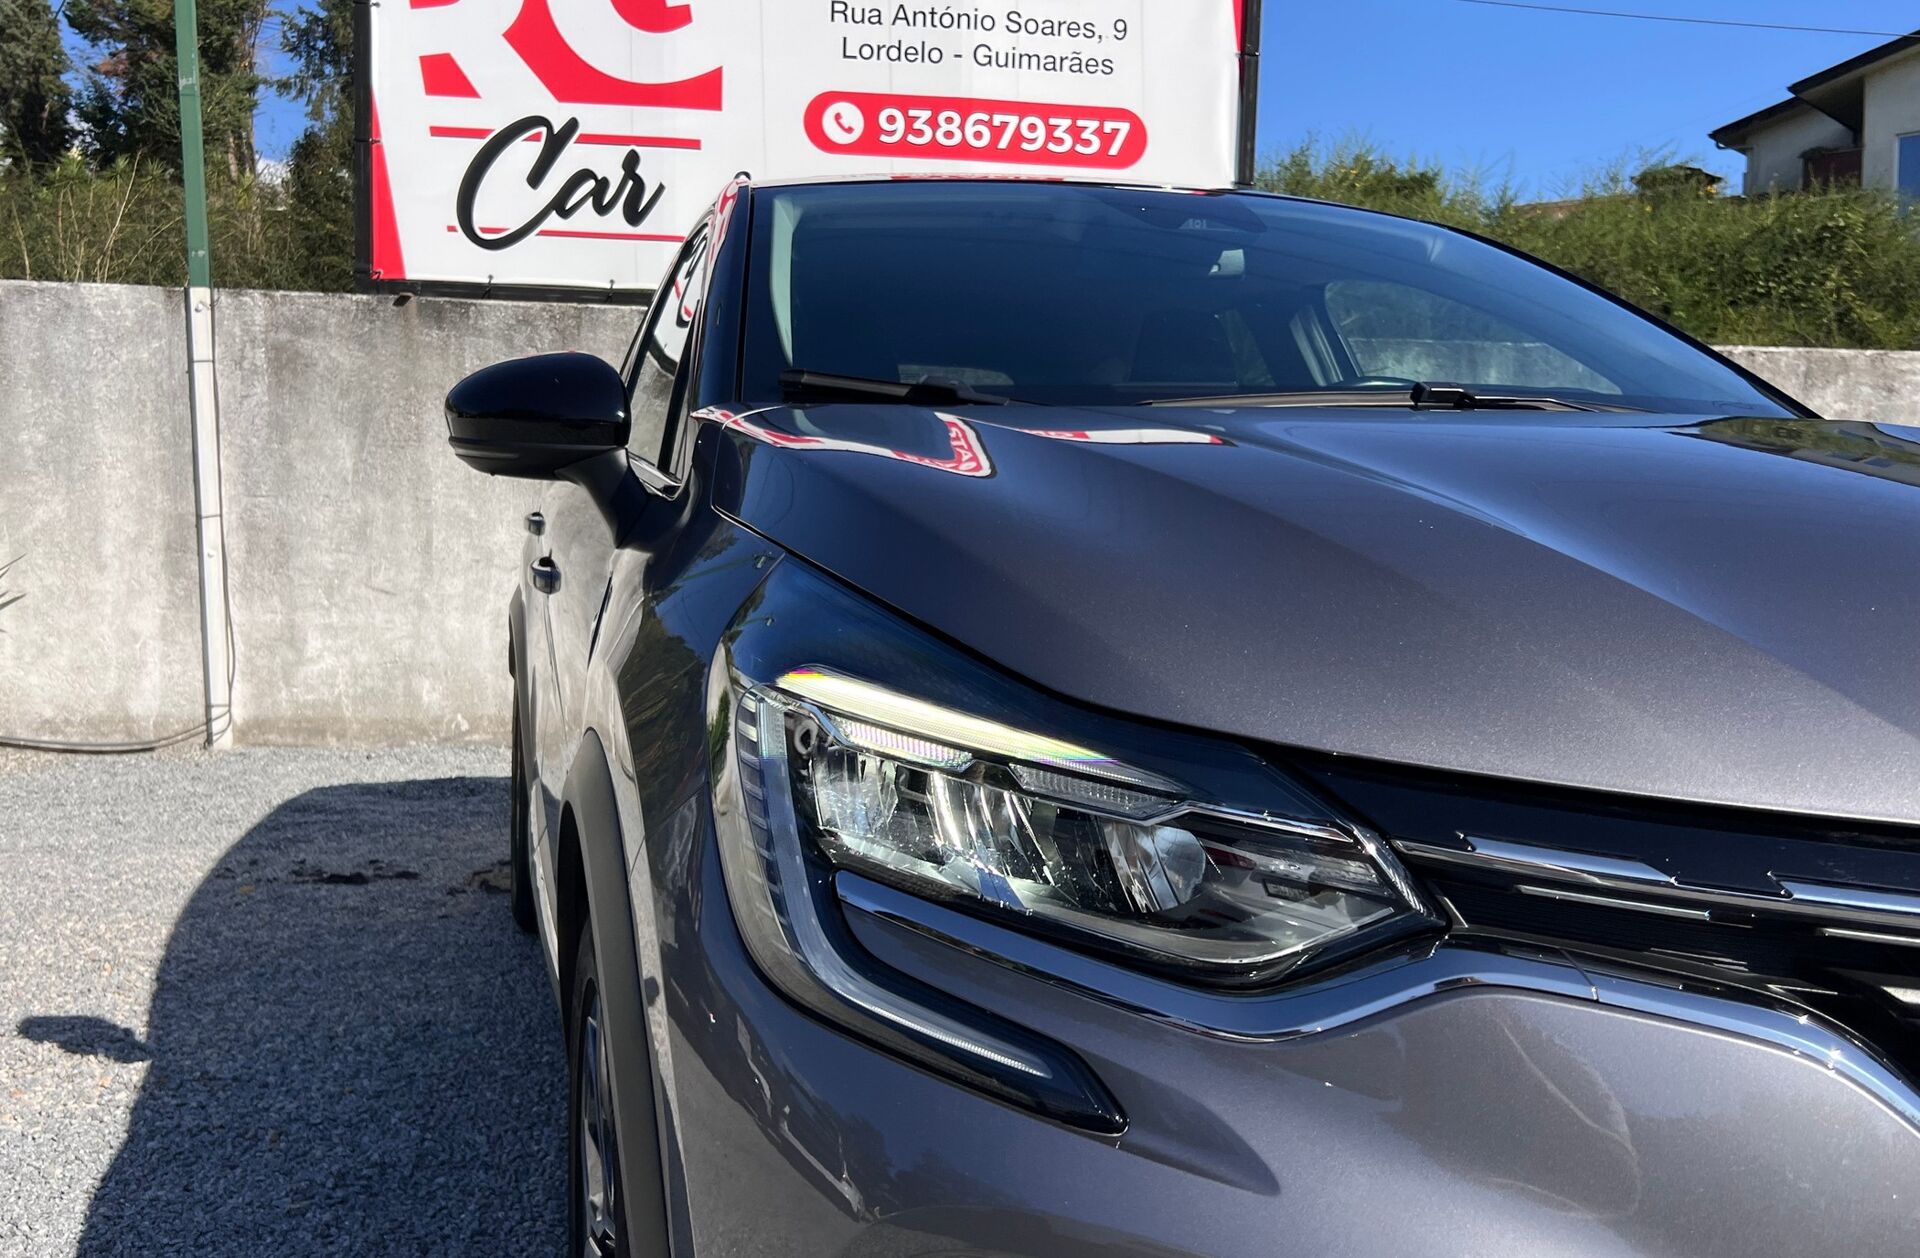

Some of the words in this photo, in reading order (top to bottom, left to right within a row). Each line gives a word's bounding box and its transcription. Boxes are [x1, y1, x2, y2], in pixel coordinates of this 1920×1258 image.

[830, 0, 883, 26] Rua
[891, 4, 996, 32] António
[1005, 10, 1103, 44] Soares,
[1113, 18, 1128, 41] 9
[842, 36, 943, 64] Lordelo
[973, 43, 1115, 76] Guimarães
[877, 106, 1131, 157] 938679337
[456, 115, 666, 251] Car
